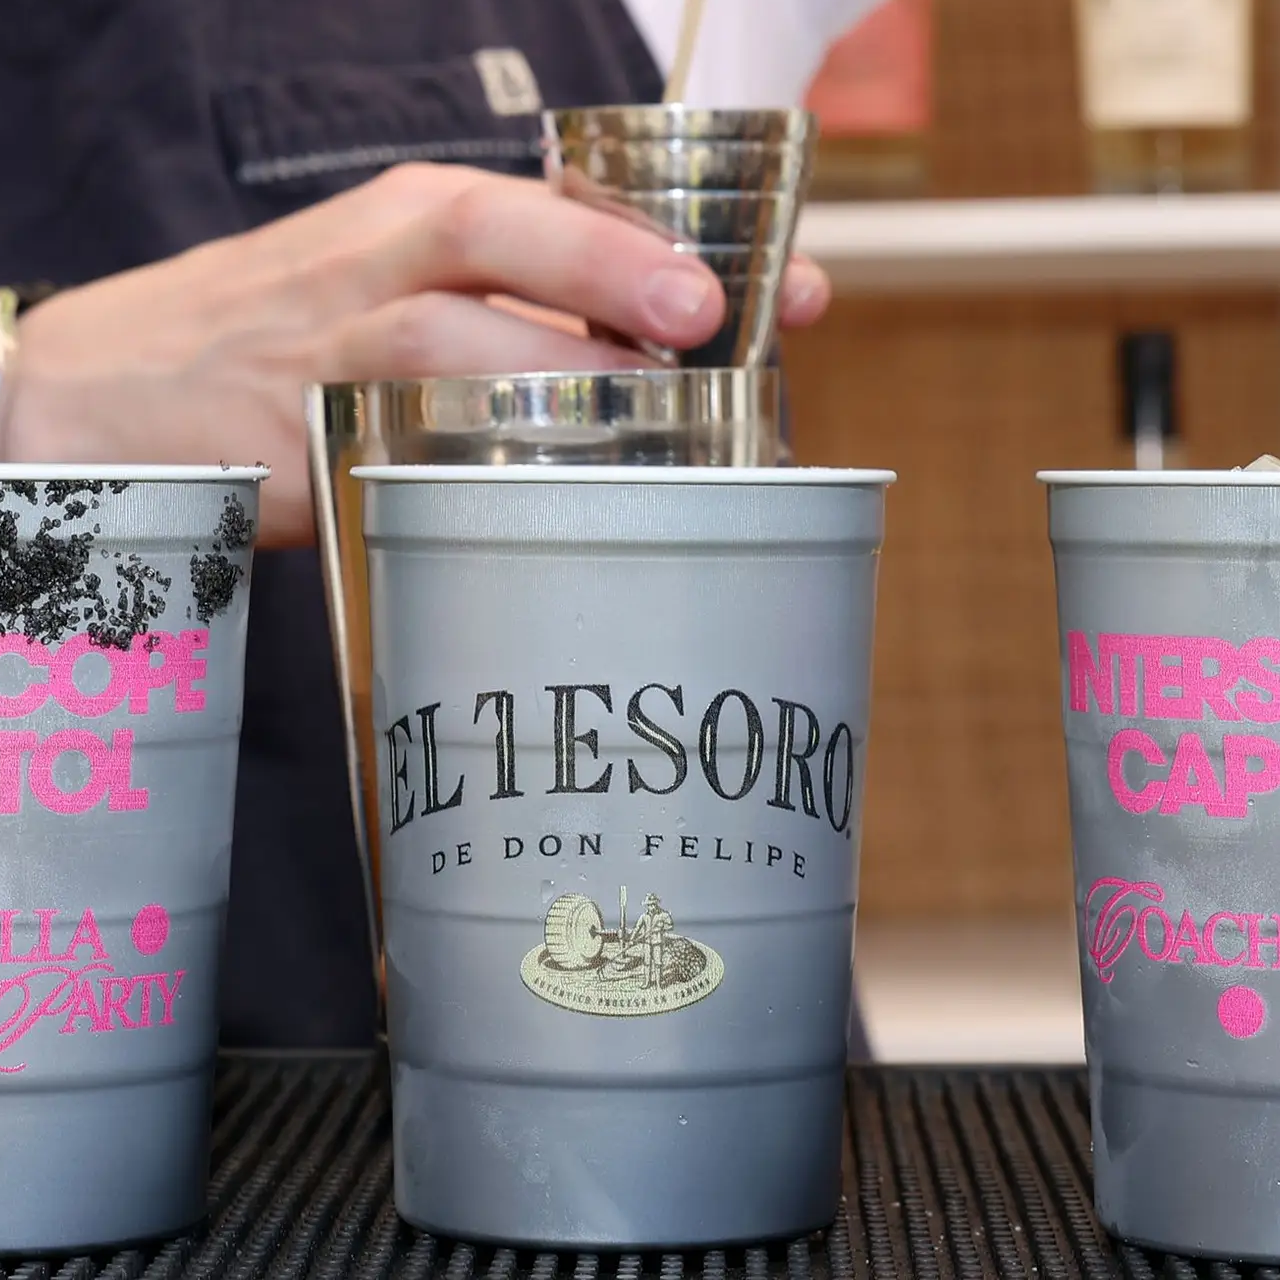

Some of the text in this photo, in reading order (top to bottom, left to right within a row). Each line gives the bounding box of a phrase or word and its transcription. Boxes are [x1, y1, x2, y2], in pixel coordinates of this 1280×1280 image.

[385, 703, 465, 837] EL
[431, 833, 807, 880] DE DON FELIPE
